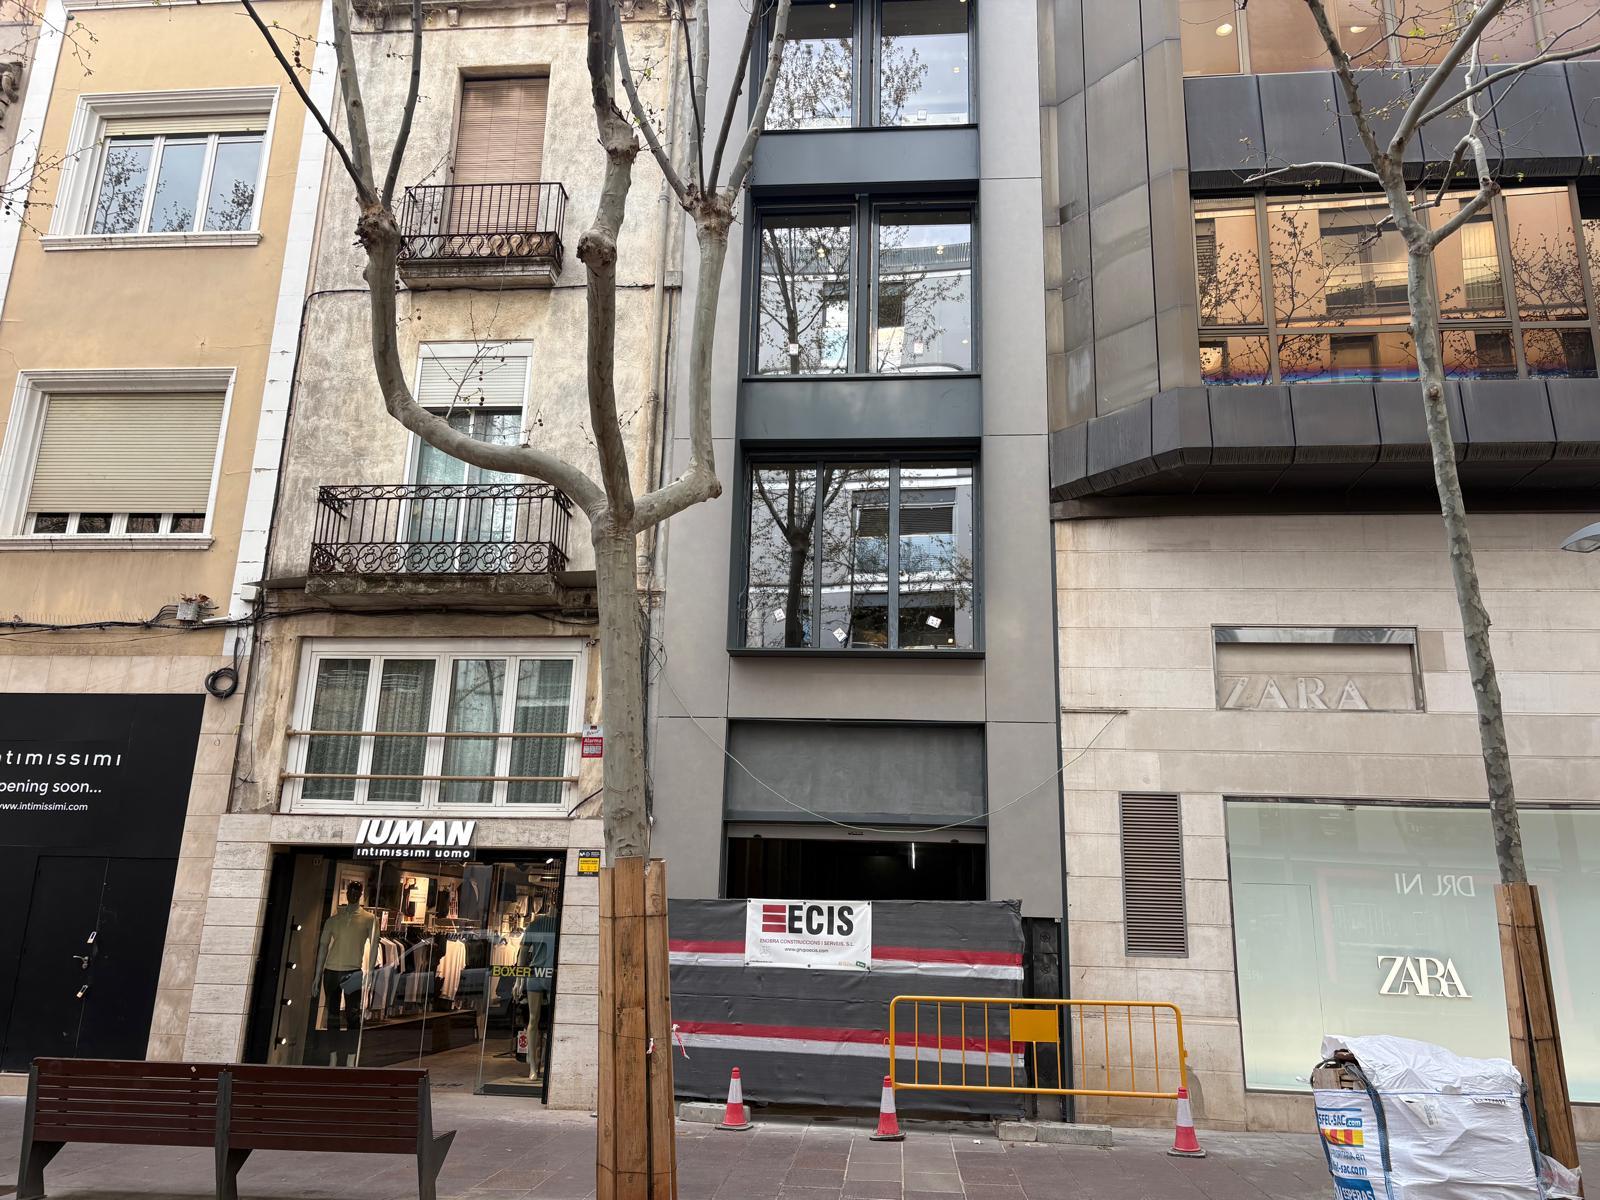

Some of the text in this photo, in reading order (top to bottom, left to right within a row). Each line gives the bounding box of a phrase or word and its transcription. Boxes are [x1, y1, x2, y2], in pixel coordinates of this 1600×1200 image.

[1221, 675, 1370, 710] ZARA
[0, 750, 122, 767] timissimi
[52, 782, 102, 793] soon...
[355, 819, 476, 846] IUMAN
[357, 847, 470, 858] intimissimi uomo
[788, 904, 854, 936] ECIS
[492, 965, 553, 978] BOXER WE
[1377, 955, 1473, 998] ZARA
